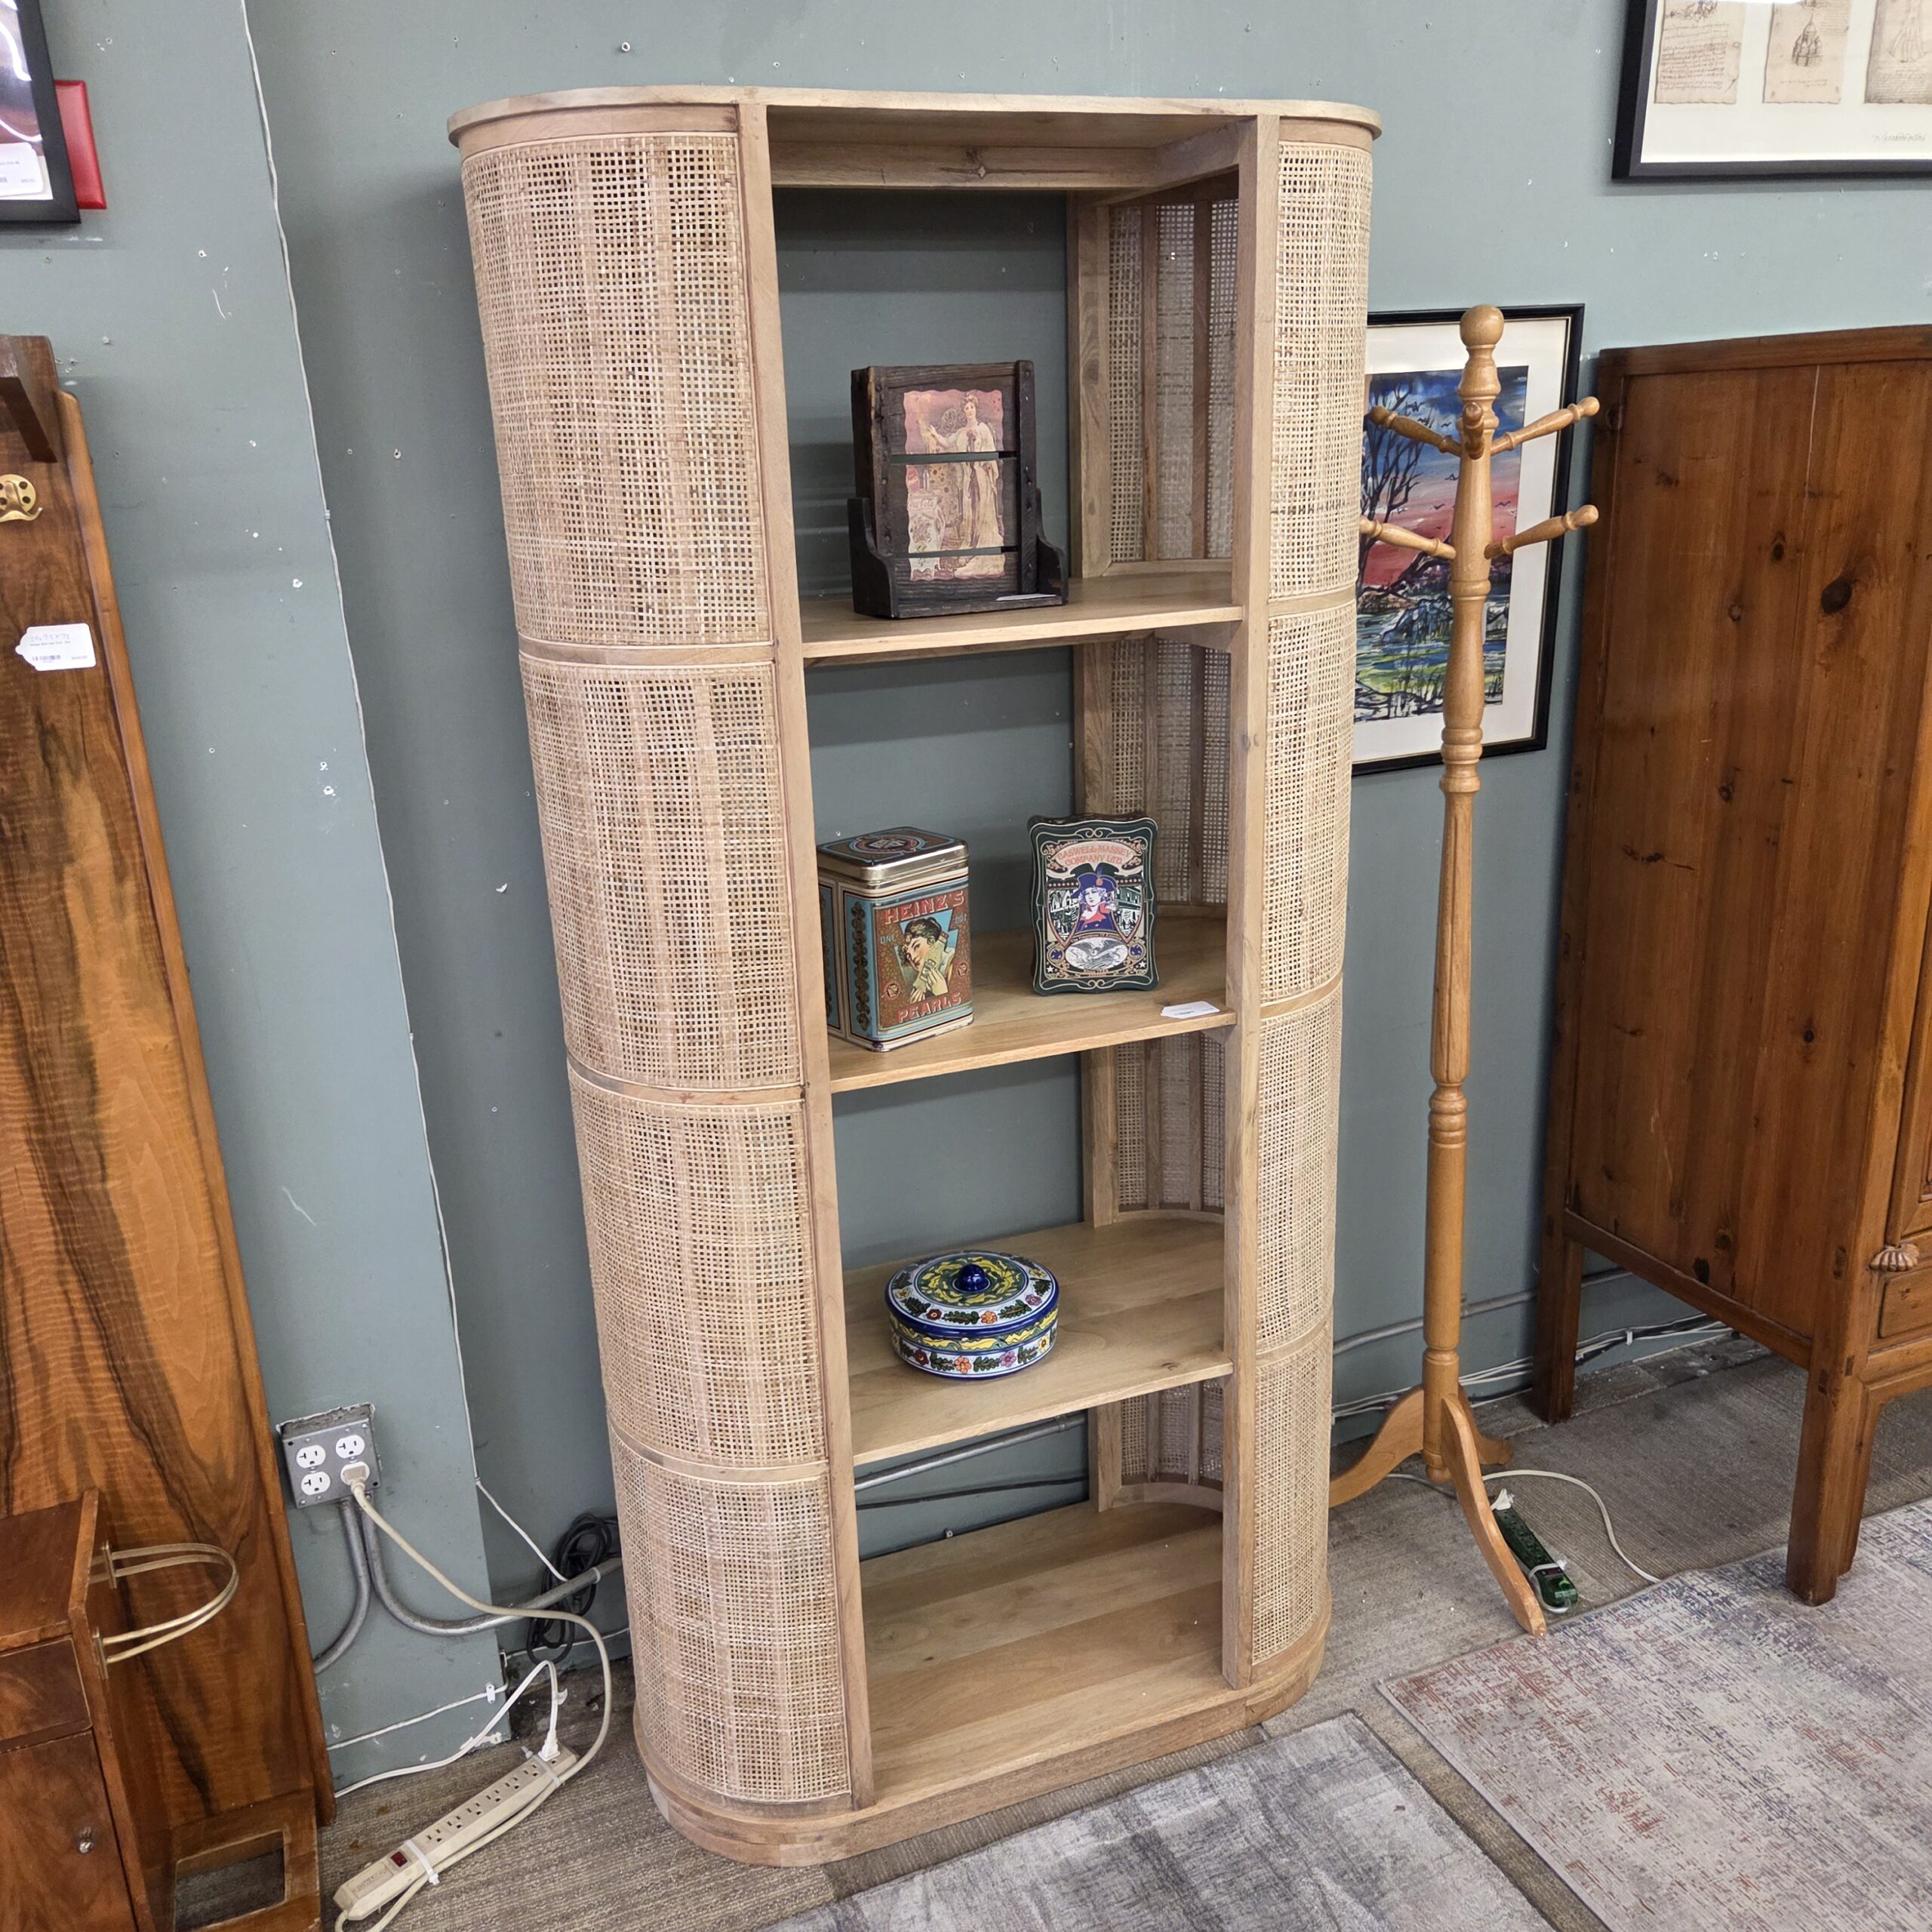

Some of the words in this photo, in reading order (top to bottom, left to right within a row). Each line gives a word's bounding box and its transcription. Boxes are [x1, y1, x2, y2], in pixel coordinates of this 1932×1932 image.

[1065, 854, 1106, 866] COMPANY
[880, 934, 896, 944] ONE
[897, 992, 962, 1023] PEARLS
